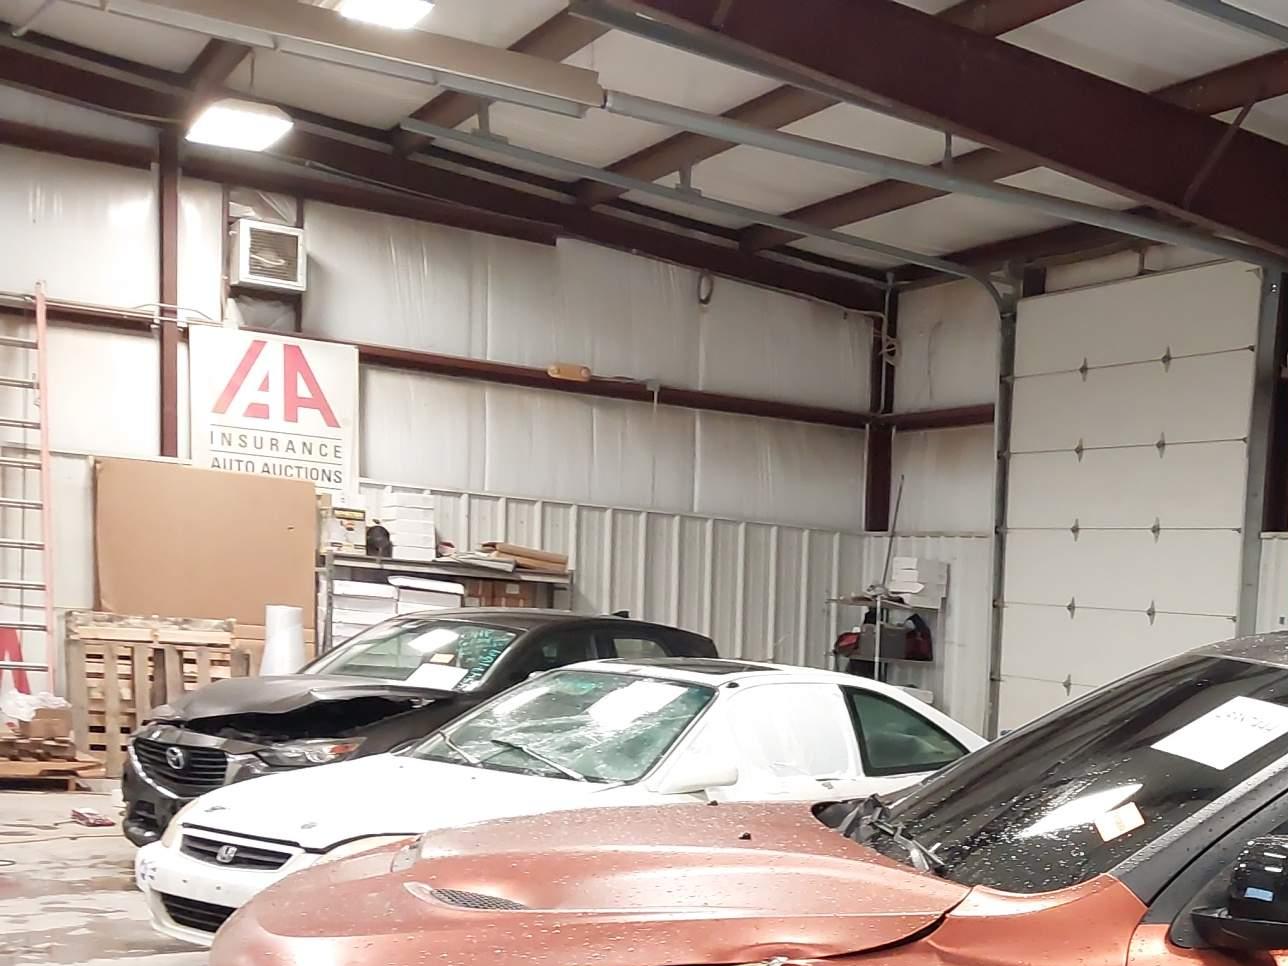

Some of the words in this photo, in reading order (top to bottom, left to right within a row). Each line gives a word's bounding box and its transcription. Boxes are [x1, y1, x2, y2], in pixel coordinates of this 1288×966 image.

[210, 431, 343, 460] INSURANCE
[210, 457, 255, 473] AUTO
[261, 462, 343, 484] AUCTIONS
